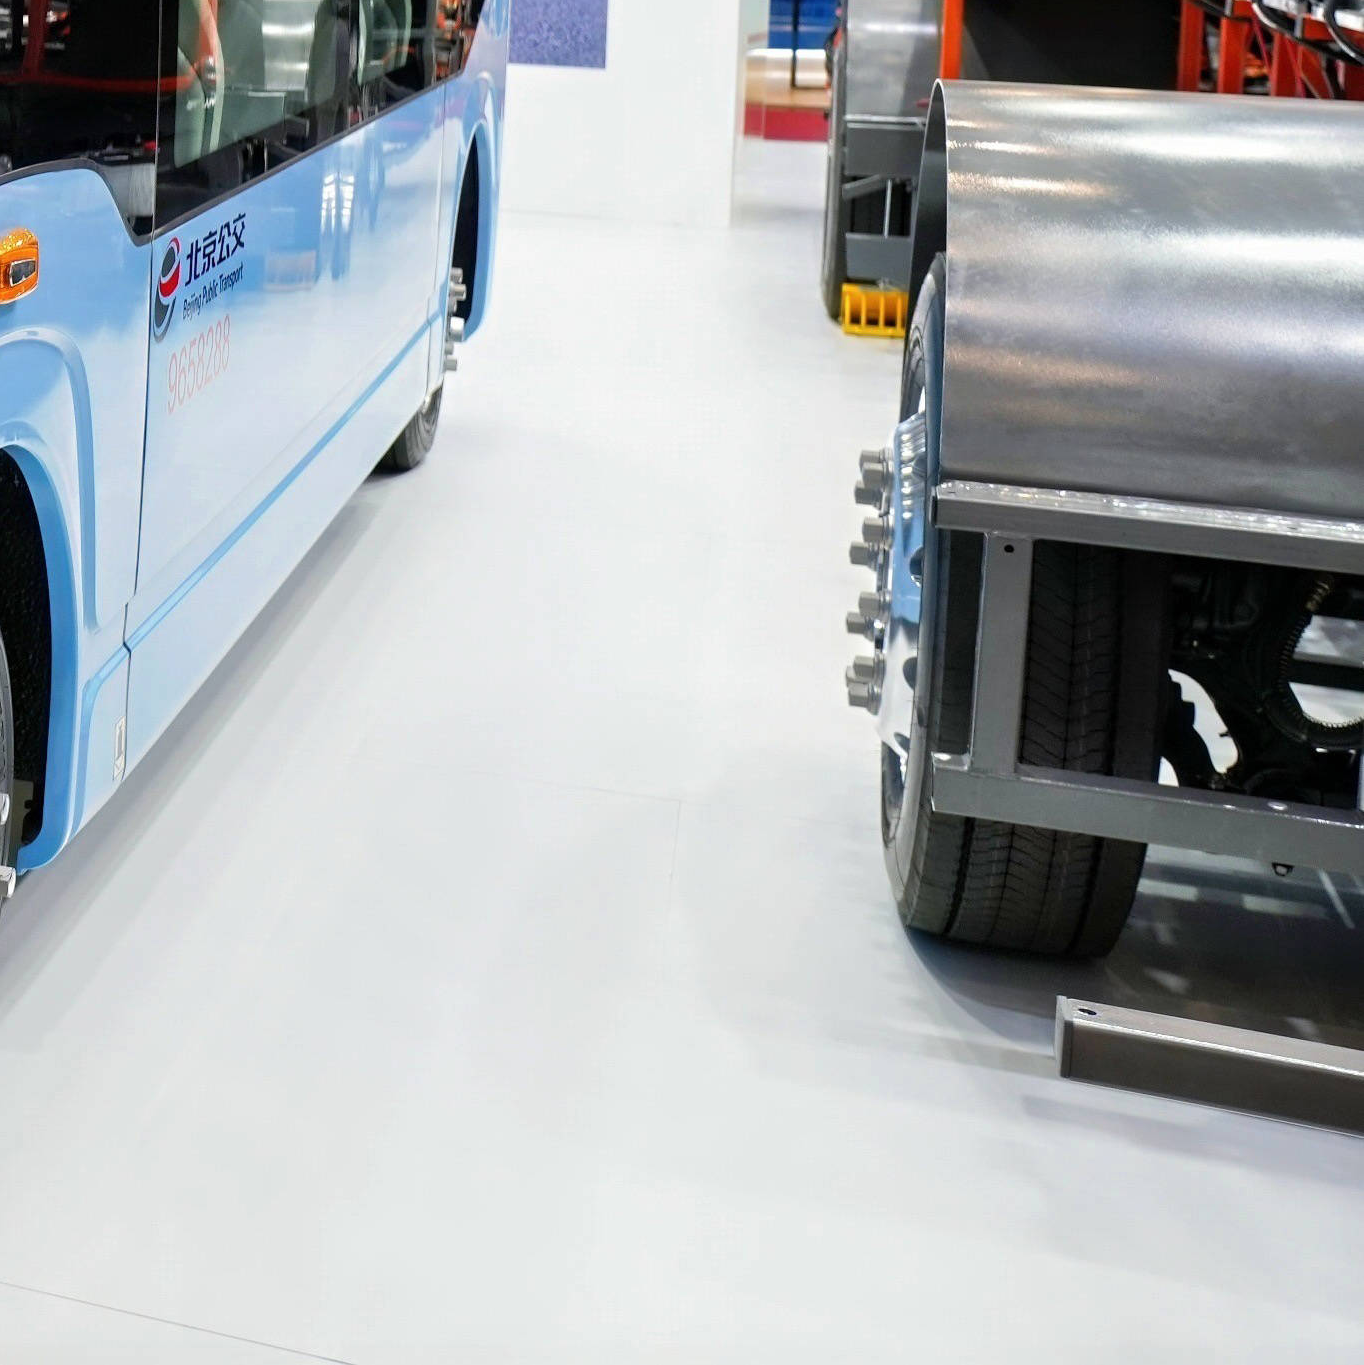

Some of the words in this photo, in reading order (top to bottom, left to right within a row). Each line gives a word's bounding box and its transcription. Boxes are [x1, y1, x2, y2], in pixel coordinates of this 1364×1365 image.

[184, 212, 247, 287] 北京公交
[182, 292, 203, 321] Beijing
[201, 280, 219, 308] Public
[218, 261, 245, 296] Transport
[167, 312, 231, 415] 9658288
